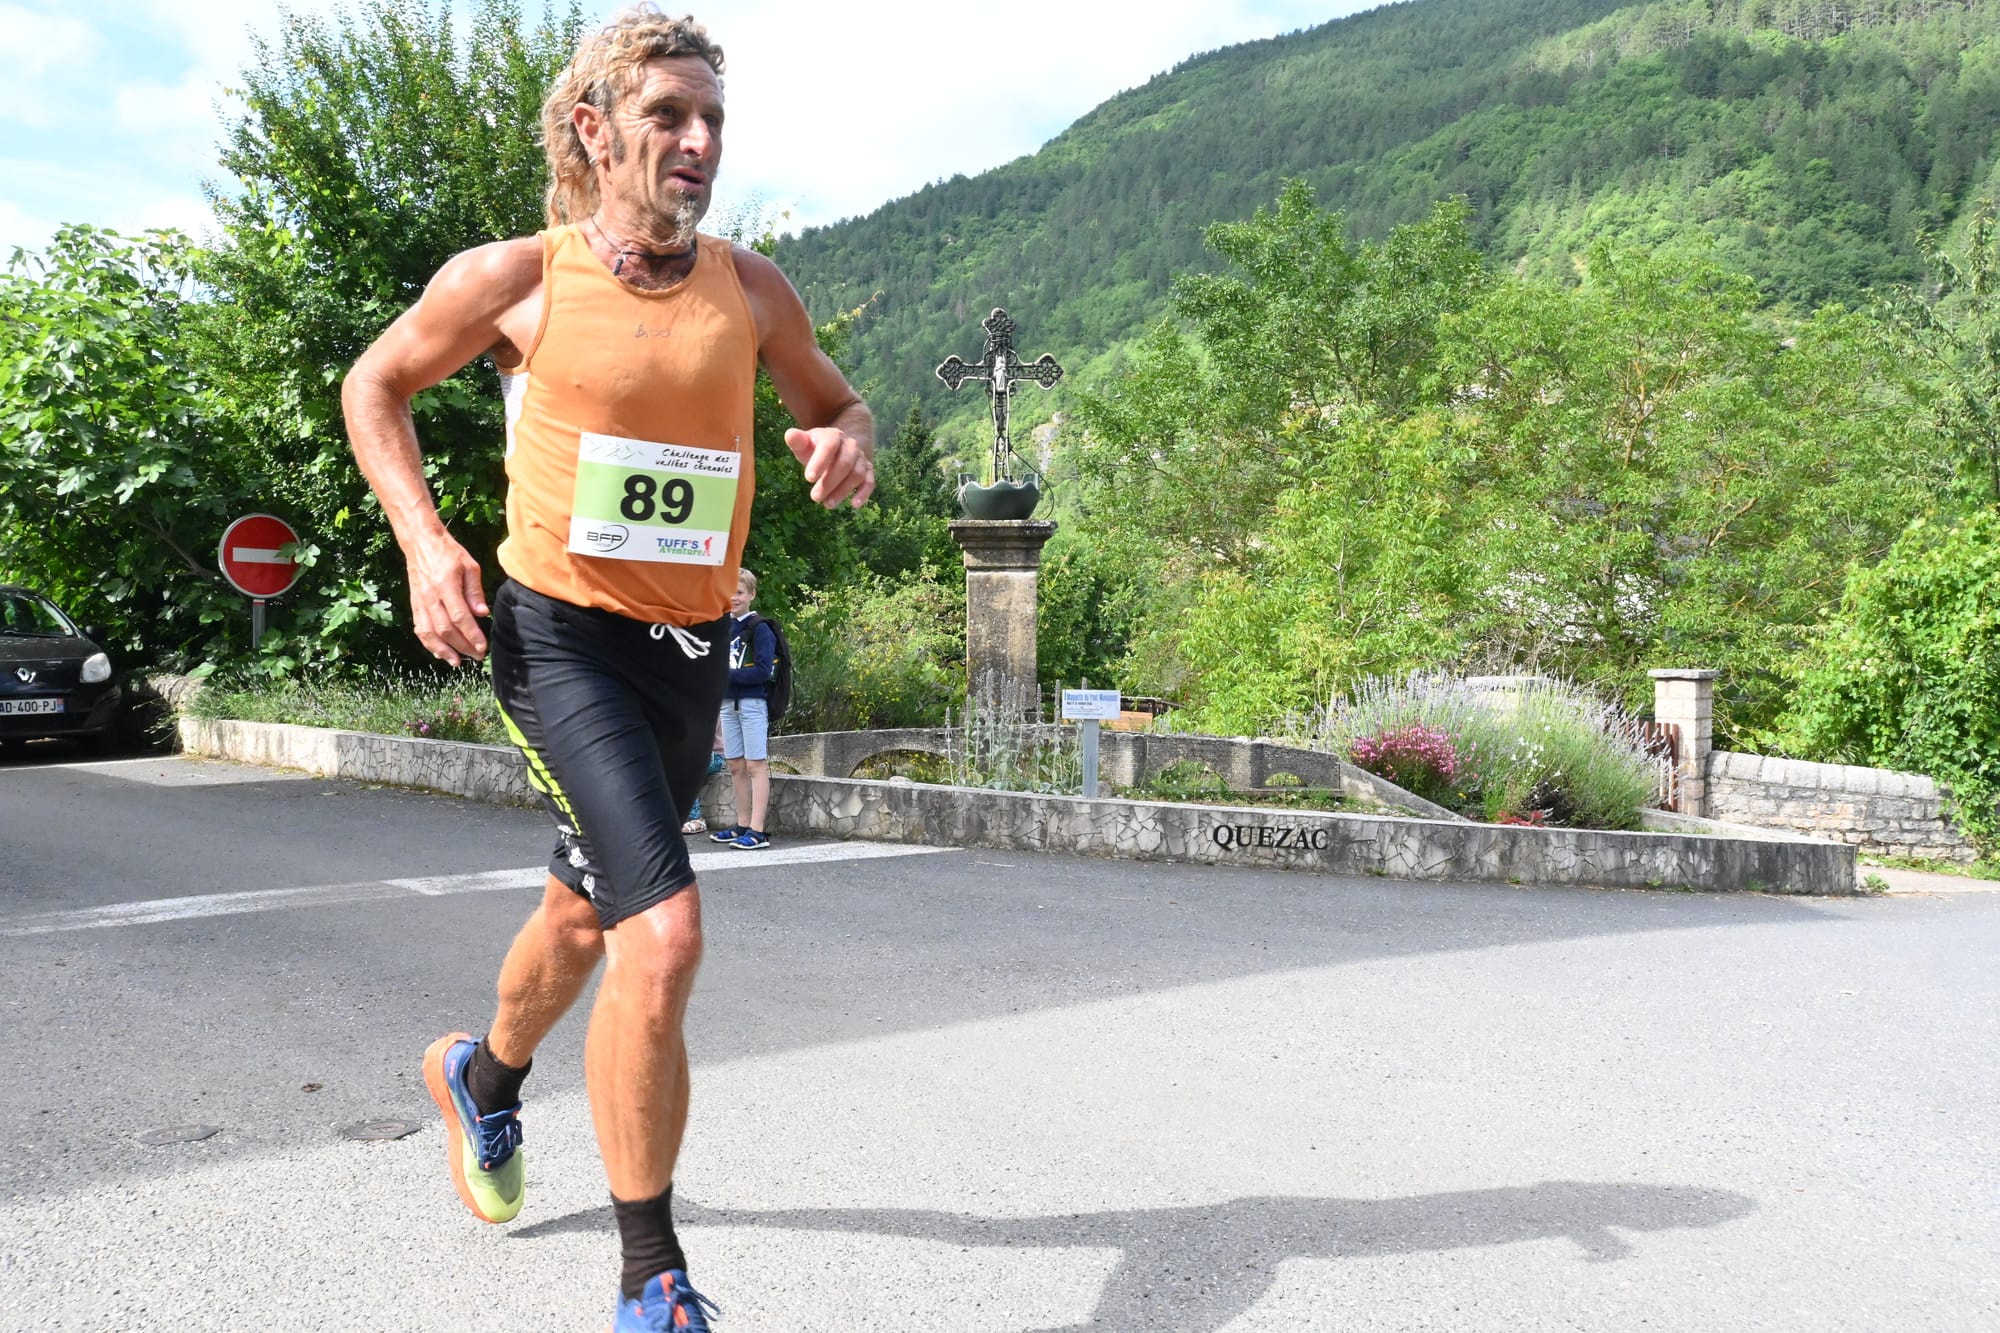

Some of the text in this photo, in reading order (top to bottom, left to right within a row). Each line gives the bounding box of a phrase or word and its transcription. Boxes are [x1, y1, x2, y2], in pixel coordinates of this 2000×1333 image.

[662, 449, 729, 463] Challenge des
[655, 458, 733, 473] vallées cévenoles
[620, 474, 695, 524] 89
[587, 531, 622, 543] BFP
[656, 537, 699, 549] TUFF'S
[659, 546, 702, 556] Aventure
[1213, 825, 1328, 851] QUEZAC
